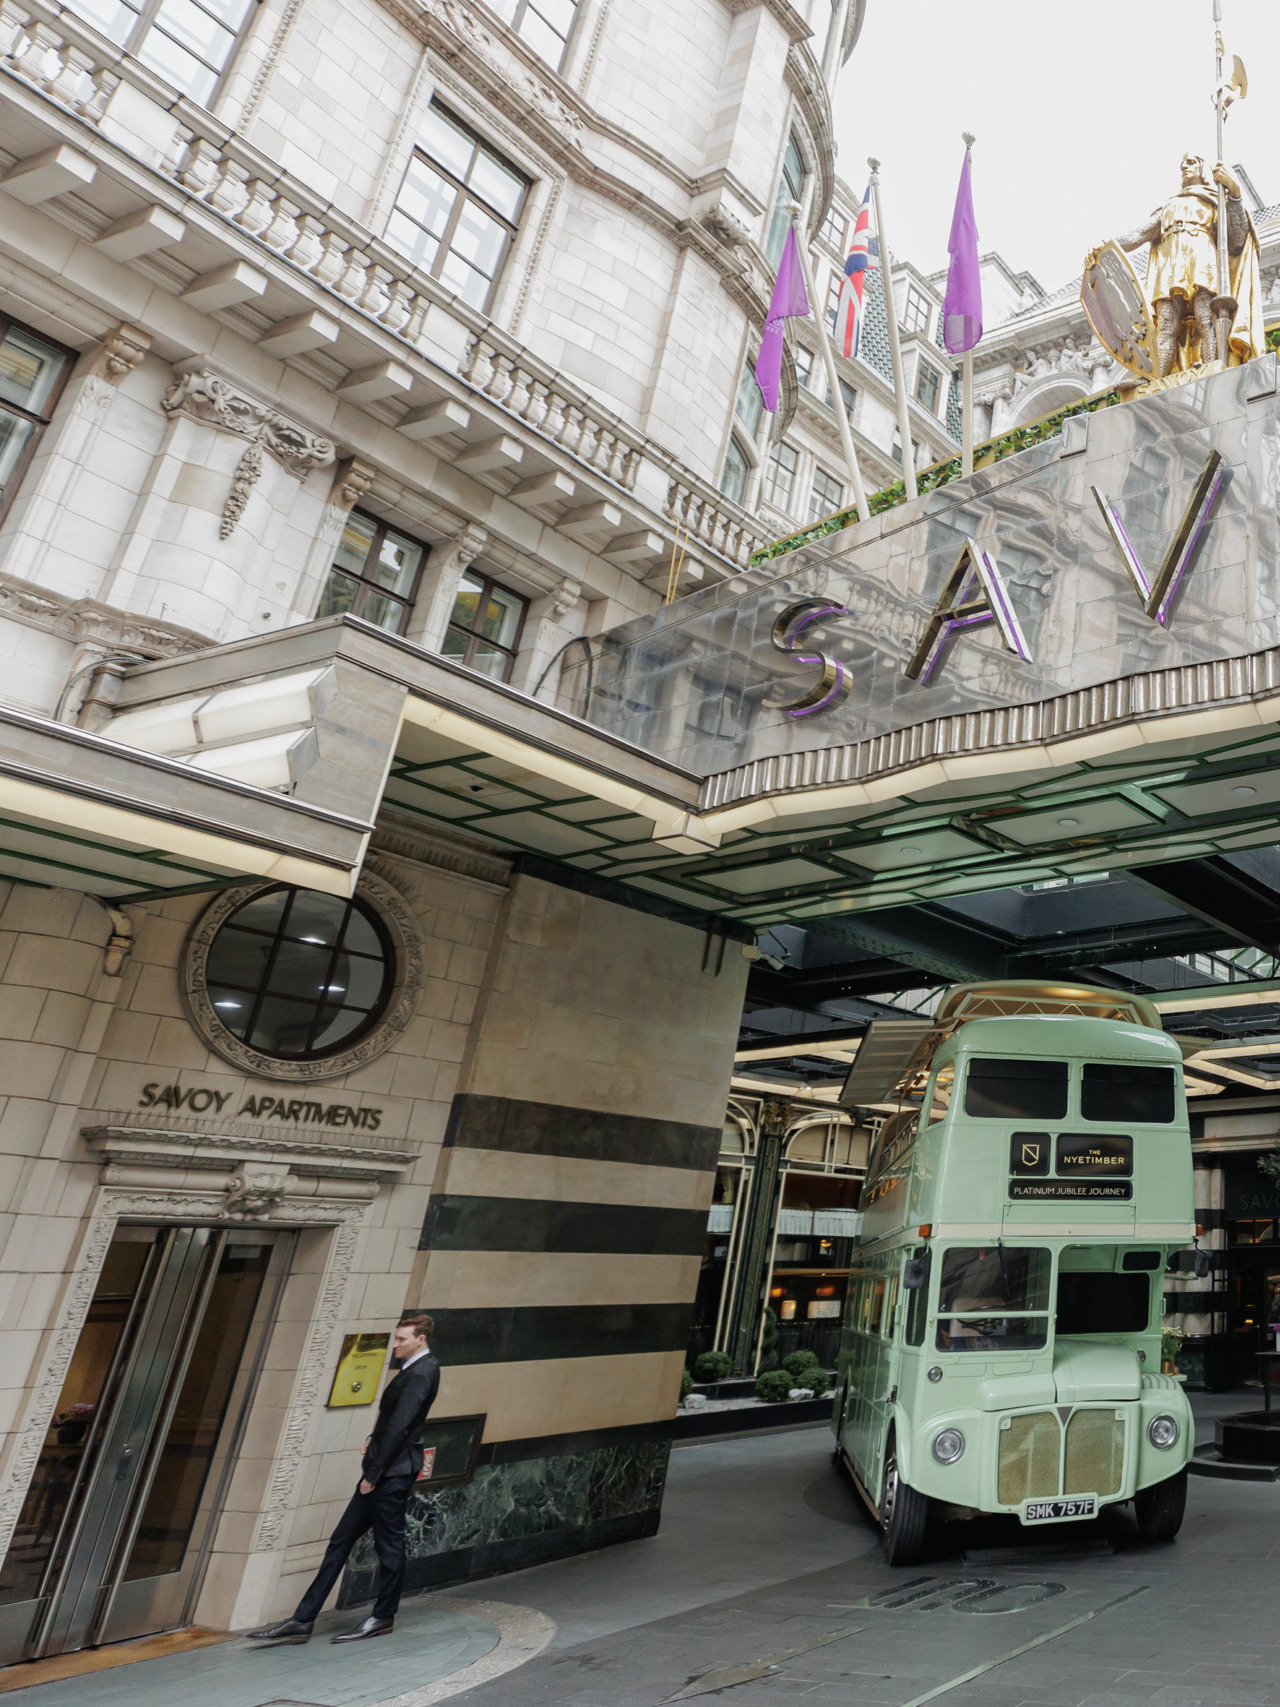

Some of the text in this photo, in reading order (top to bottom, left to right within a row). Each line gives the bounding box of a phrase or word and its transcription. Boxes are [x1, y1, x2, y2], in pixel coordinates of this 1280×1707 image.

[138, 1083, 384, 1132] SAVOY APARTMENTS
[1063, 1156, 1125, 1165] NYETIMBER
[1013, 1187, 1126, 1196] PLATINUM JUBILEE JOURNEY
[1027, 1500, 1093, 1519] SMK 757F
